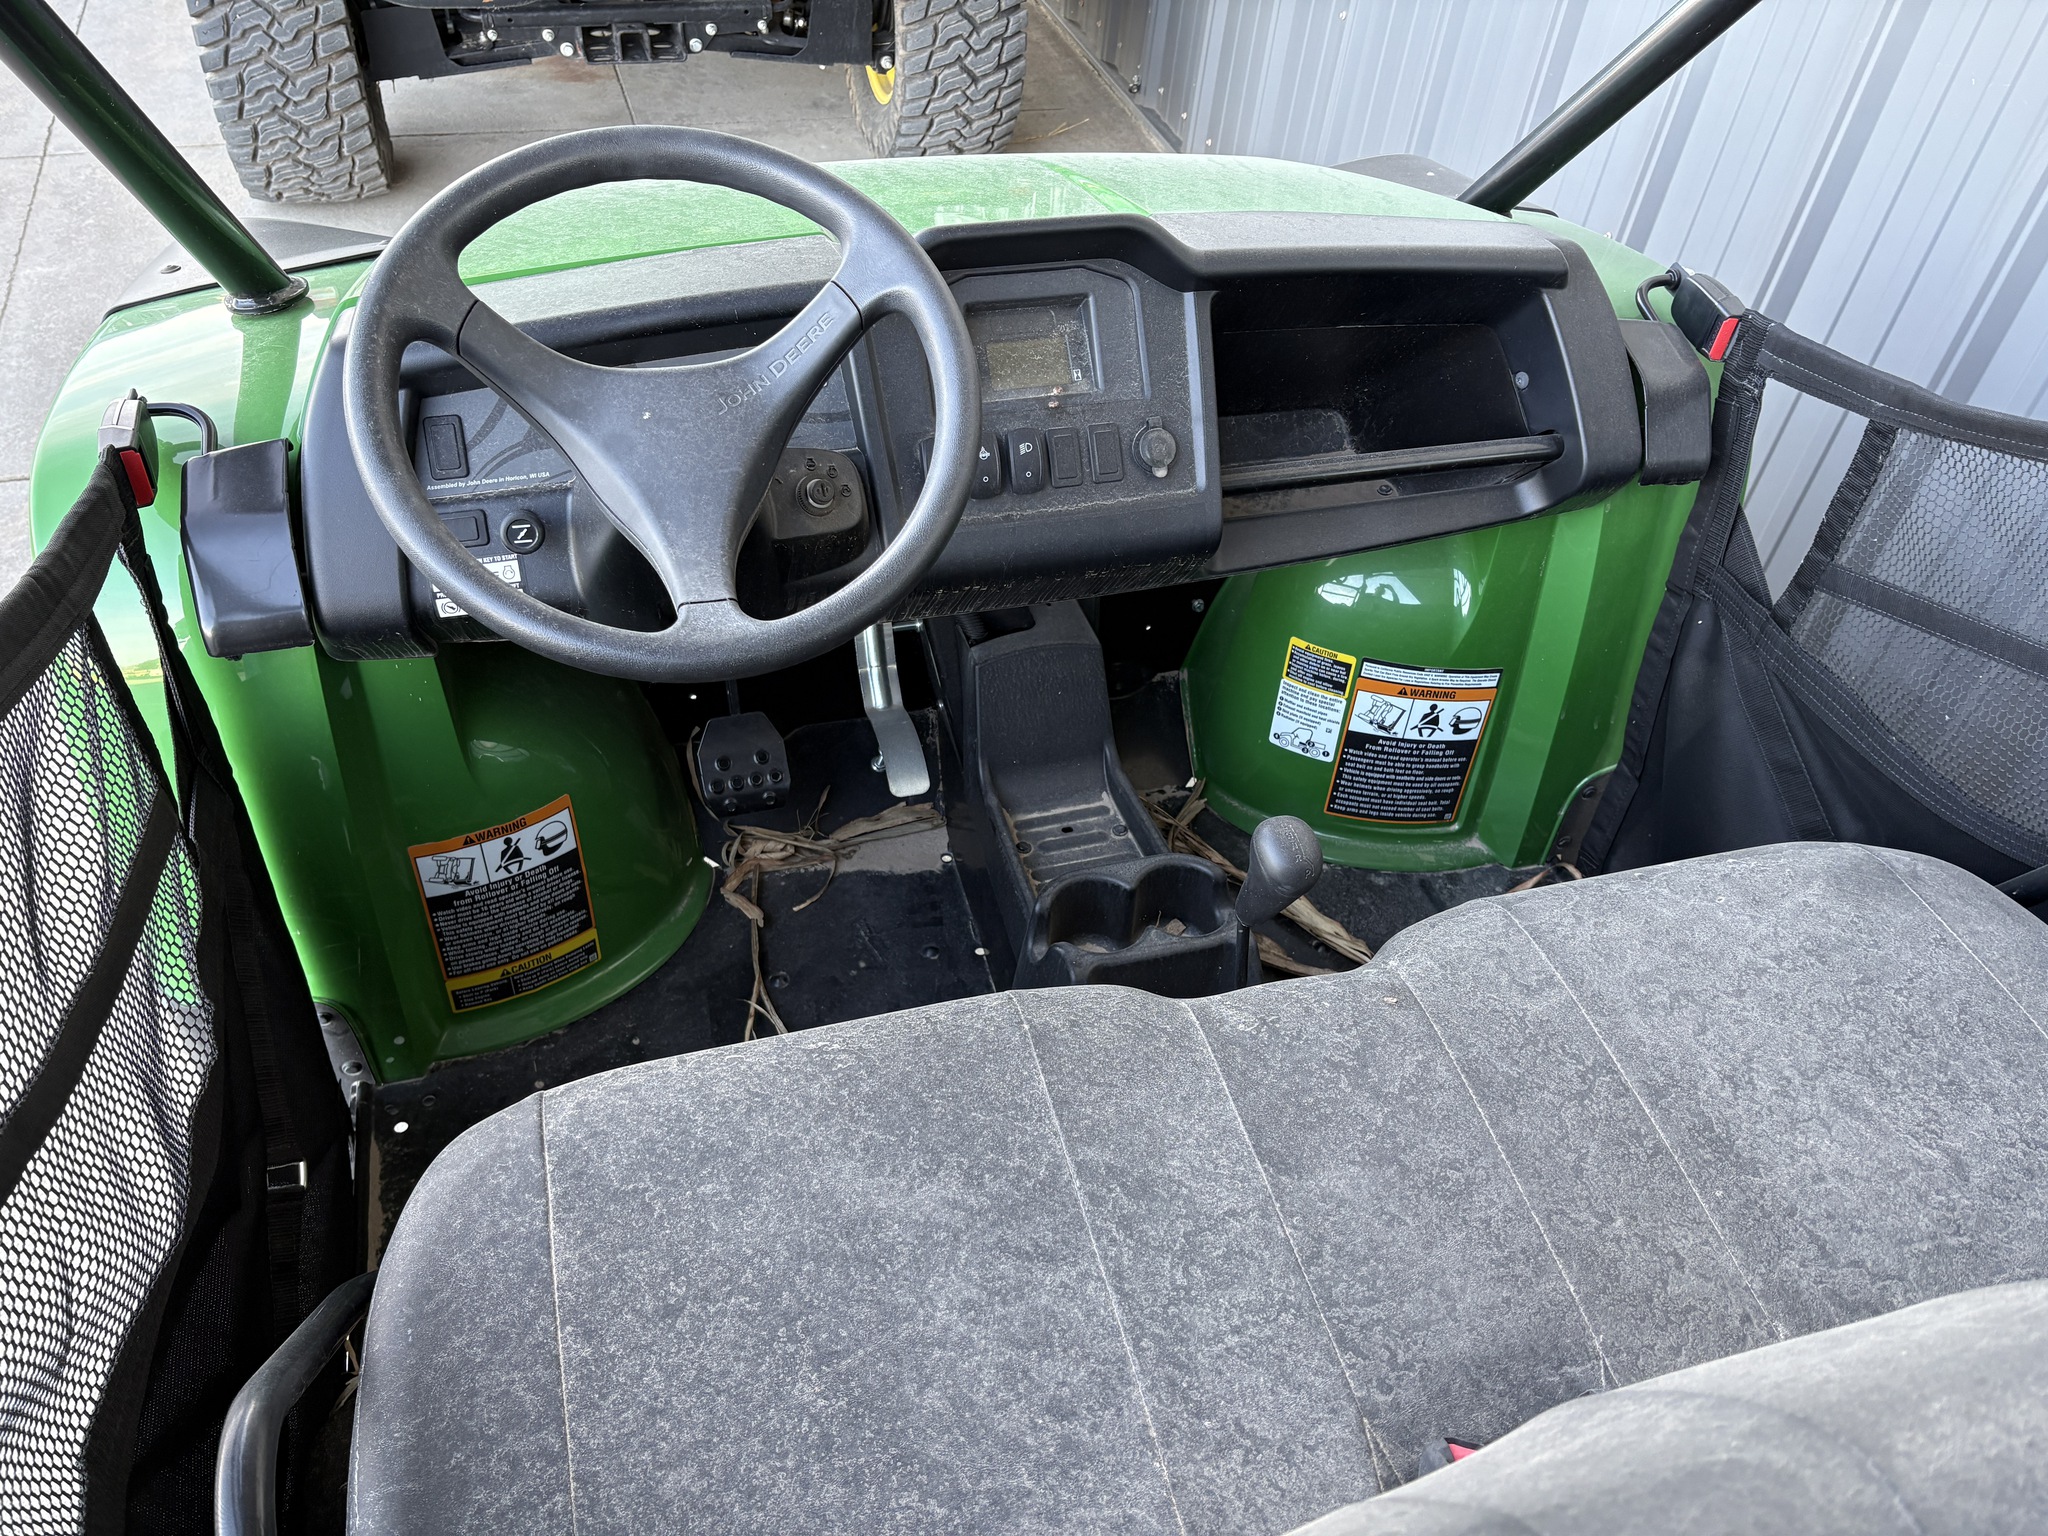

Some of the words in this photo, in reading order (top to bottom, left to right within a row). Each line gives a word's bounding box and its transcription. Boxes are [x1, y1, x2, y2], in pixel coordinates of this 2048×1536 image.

[714, 374, 771, 416] JOHN
[768, 312, 837, 379] DEERE
[426, 482, 458, 490] Assembled
[1312, 646, 1338, 660] CAUTION
[1410, 688, 1456, 699] WARNING
[1347, 754, 1374, 764] Passengers
[474, 817, 527, 842] WARNING
[453, 898, 472, 906] from
[475, 887, 508, 901] Rollover
[521, 872, 547, 886] Falling
[549, 865, 559, 875] Off
[465, 886, 487, 897] Avoid
[490, 878, 512, 890] Injury
[525, 865, 546, 878] Death
[510, 952, 552, 974] CAUTION
